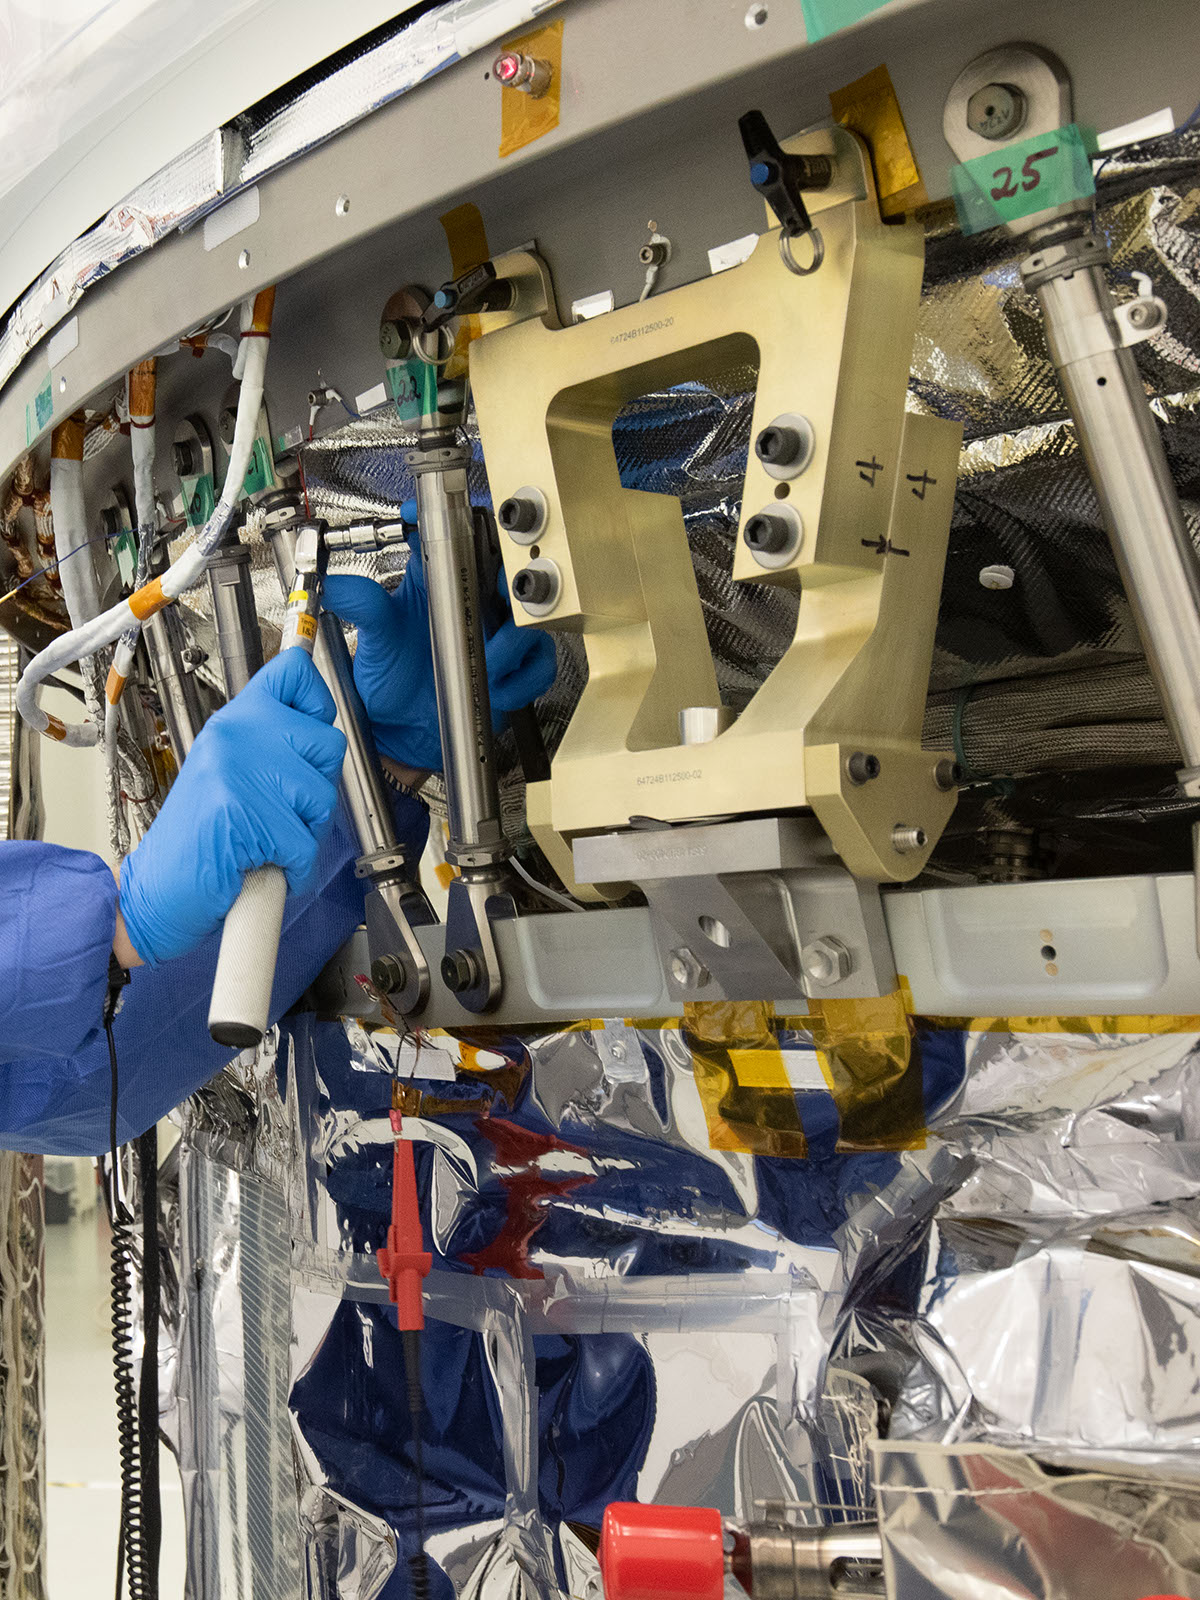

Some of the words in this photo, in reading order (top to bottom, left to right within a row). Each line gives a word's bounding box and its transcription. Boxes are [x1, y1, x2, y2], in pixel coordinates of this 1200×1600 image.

[990, 146, 1059, 201] 25
[397, 375, 422, 407] 22
[856, 455, 884, 488] 4
[906, 469, 937, 501] 4
